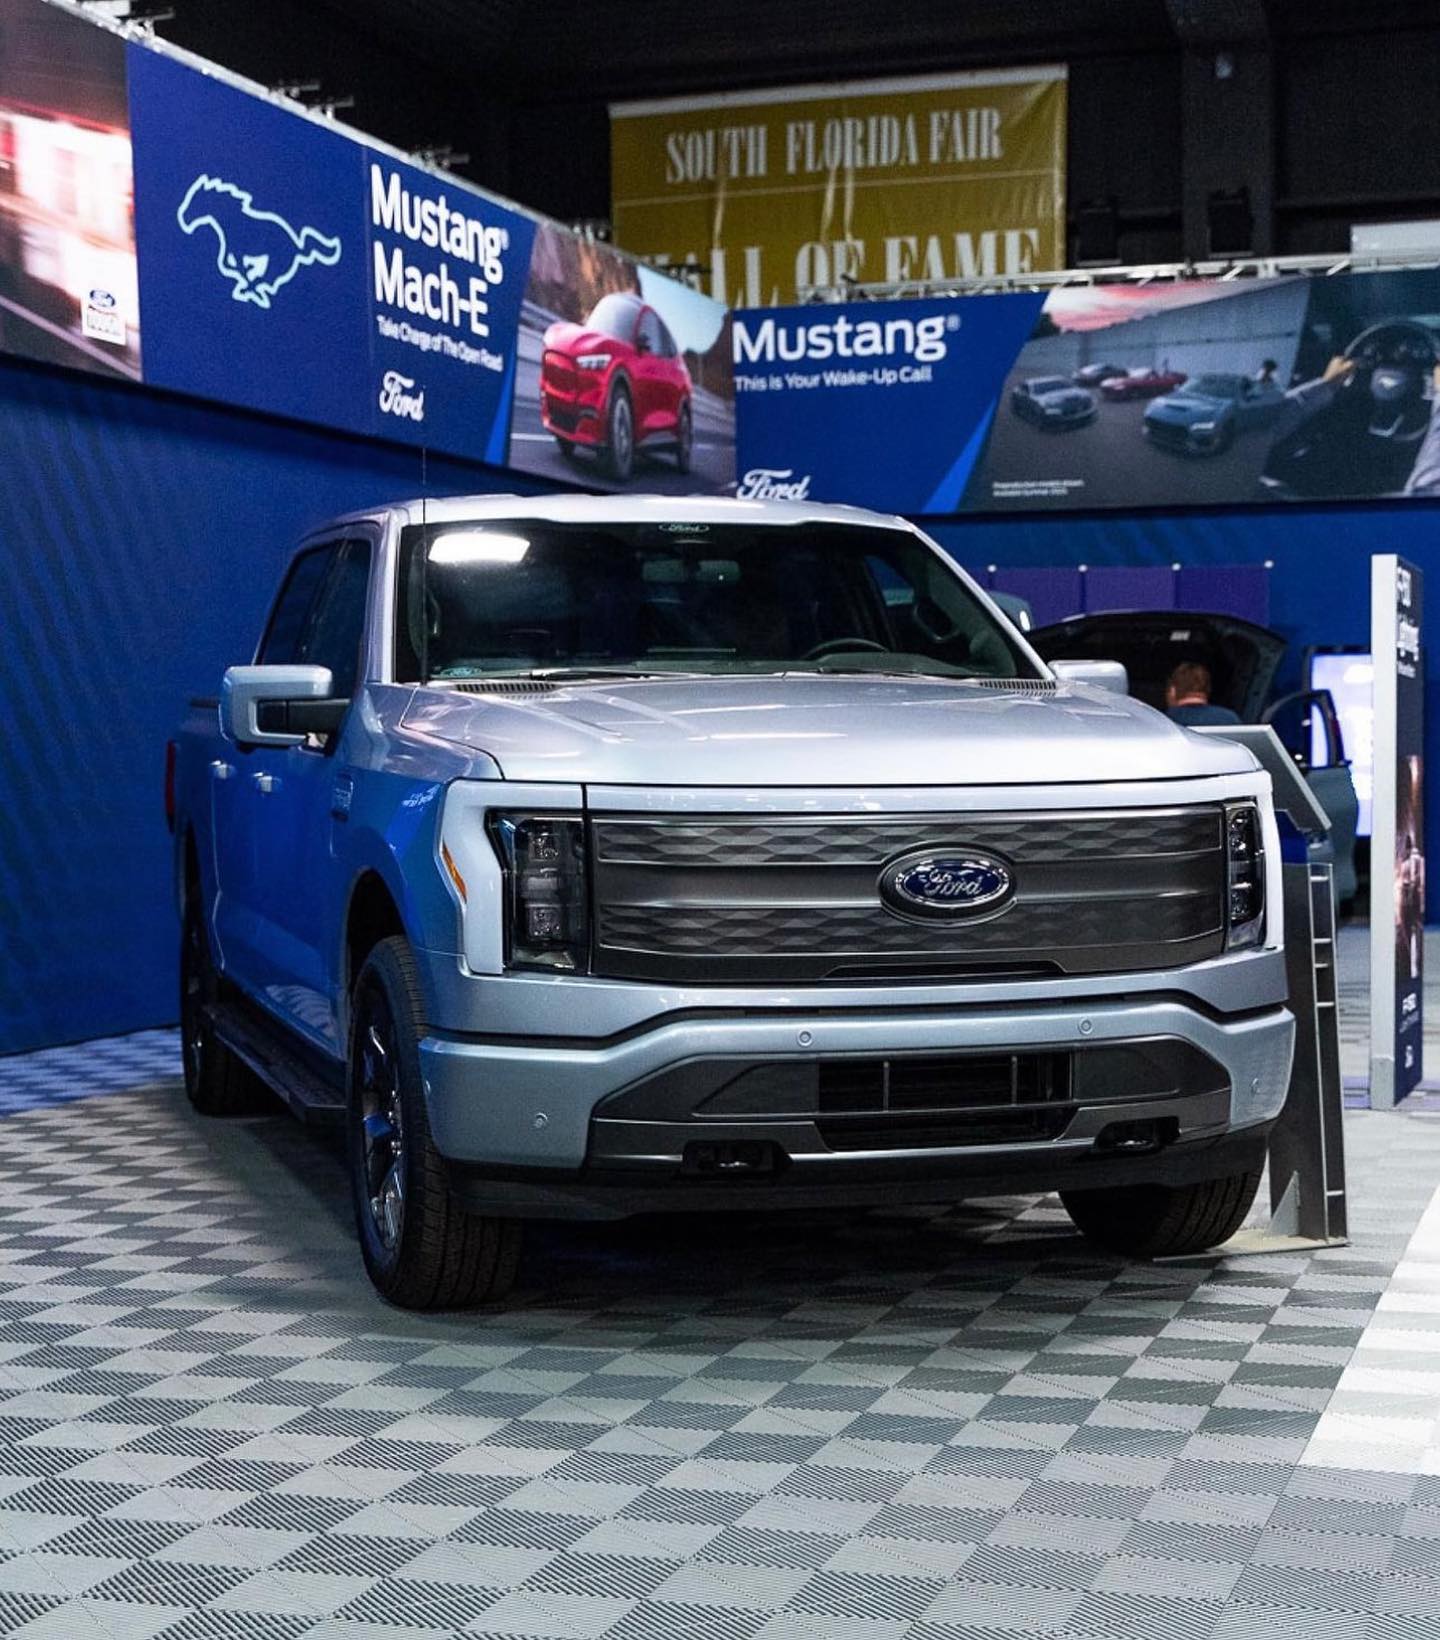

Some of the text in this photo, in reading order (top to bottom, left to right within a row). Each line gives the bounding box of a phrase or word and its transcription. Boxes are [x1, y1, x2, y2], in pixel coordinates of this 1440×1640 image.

[666, 107, 1003, 184] SOUTH FLORIDA FAIR
[884, 228, 1040, 282] FAME
[374, 241, 489, 338] Mach-E
[379, 370, 424, 422] Ford
[734, 365, 932, 392] This is Your Wake-Up Call
[736, 468, 811, 501] Ford
[921, 868, 983, 897] Ford
